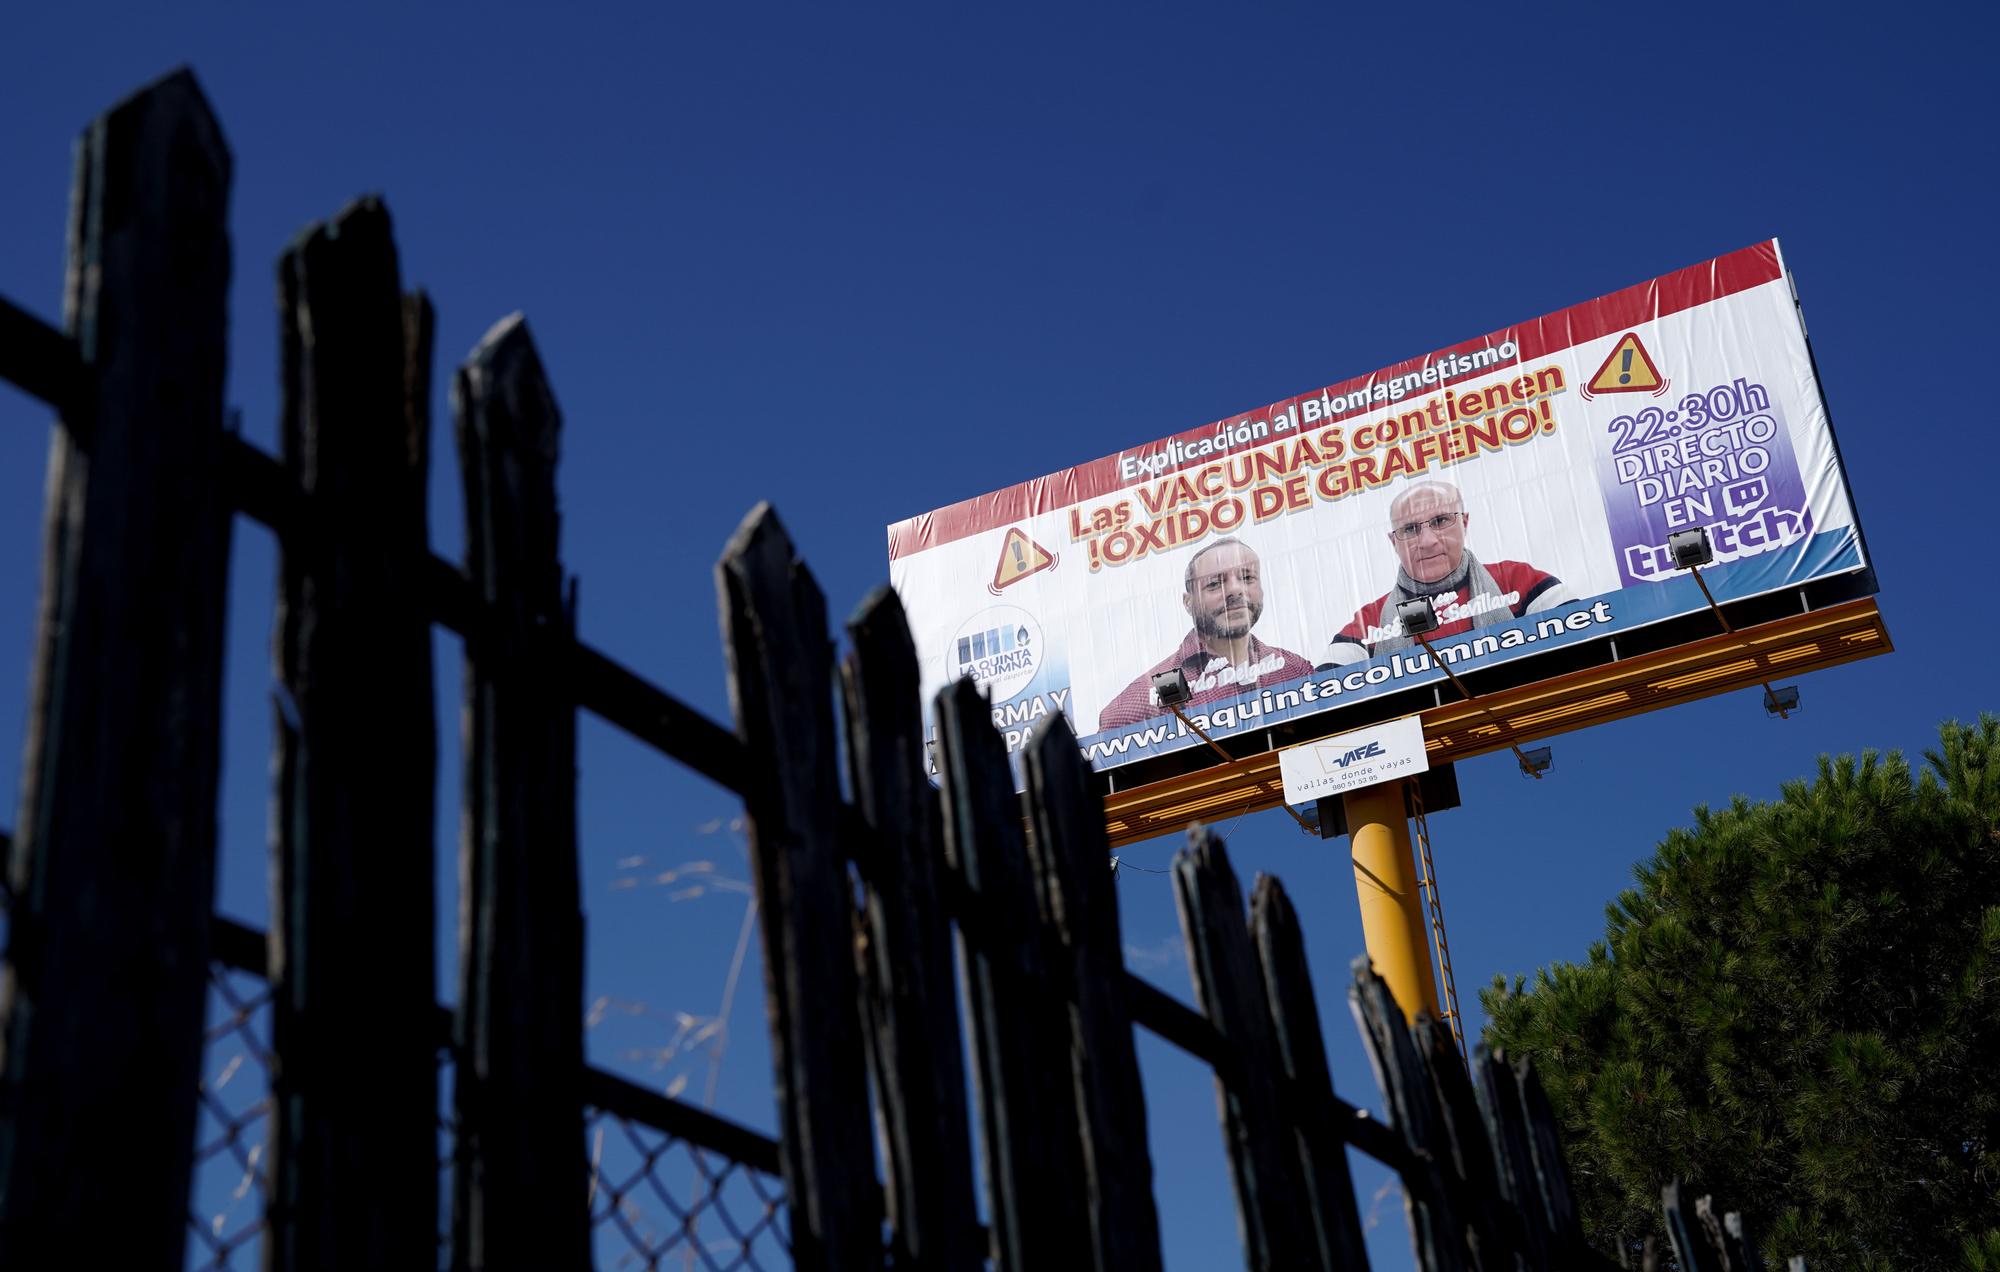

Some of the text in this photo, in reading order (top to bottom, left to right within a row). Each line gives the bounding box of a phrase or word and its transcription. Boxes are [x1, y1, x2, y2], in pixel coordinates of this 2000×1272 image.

[1120, 341, 1518, 480] Explicación al Biomagnetismo
[1608, 377, 1771, 455] 22:30h
[1070, 364, 1565, 540] Las VACUNAS contienen
[1251, 473, 1313, 522] DE
[1315, 399, 1558, 501] GRAFENO!
[1615, 414, 1777, 485] DIRECTO
[1635, 446, 1771, 507] DIARIO
[1663, 490, 1714, 528] EN
[1625, 508, 1807, 581] ttch
[1441, 590, 1520, 625] Sevillano
[971, 657, 1033, 682] OLUMNA
[979, 648, 1032, 671] QUINTA
[1217, 653, 1286, 686] Delgado
[1048, 688, 1070, 712] Y
[1332, 740, 1386, 768] VAFE
[1297, 757, 1412, 791] vallas donde vayas
[1347, 780, 1356, 788] 51
[1358, 777, 1368, 786] 53
[1368, 774, 1378, 783] 95
